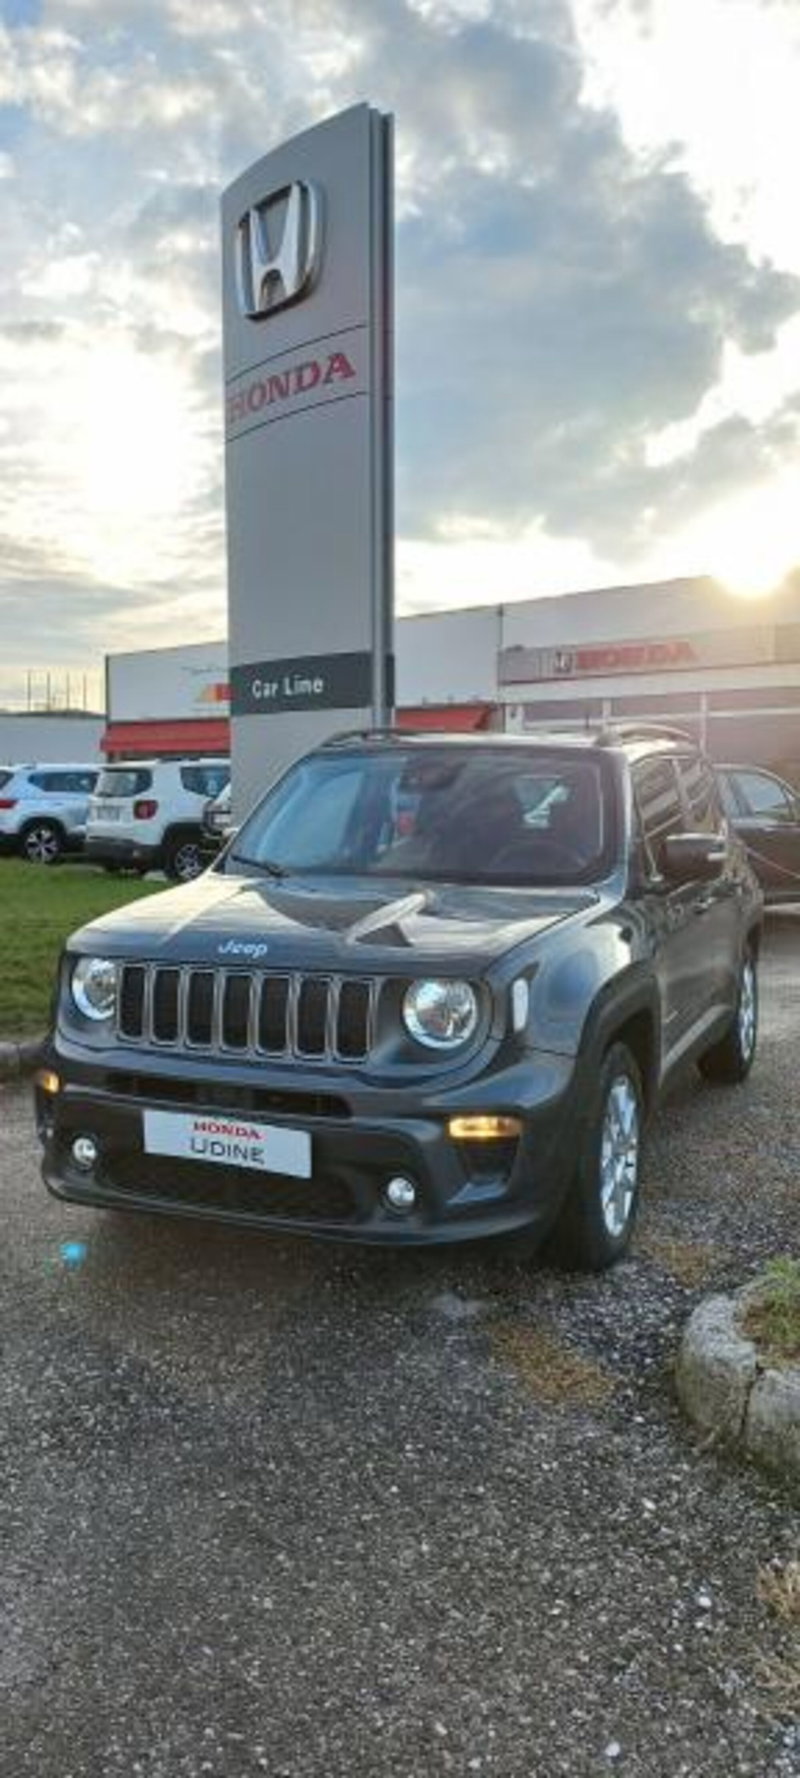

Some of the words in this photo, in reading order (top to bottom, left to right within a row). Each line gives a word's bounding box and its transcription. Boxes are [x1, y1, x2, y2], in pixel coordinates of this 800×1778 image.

[226, 352, 356, 424] HONDA
[252, 679, 279, 699] Car
[283, 674, 324, 696] Line
[217, 939, 268, 959] Jeep
[193, 1121, 263, 1140] HONDA
[190, 1136, 265, 1166] UDINE
